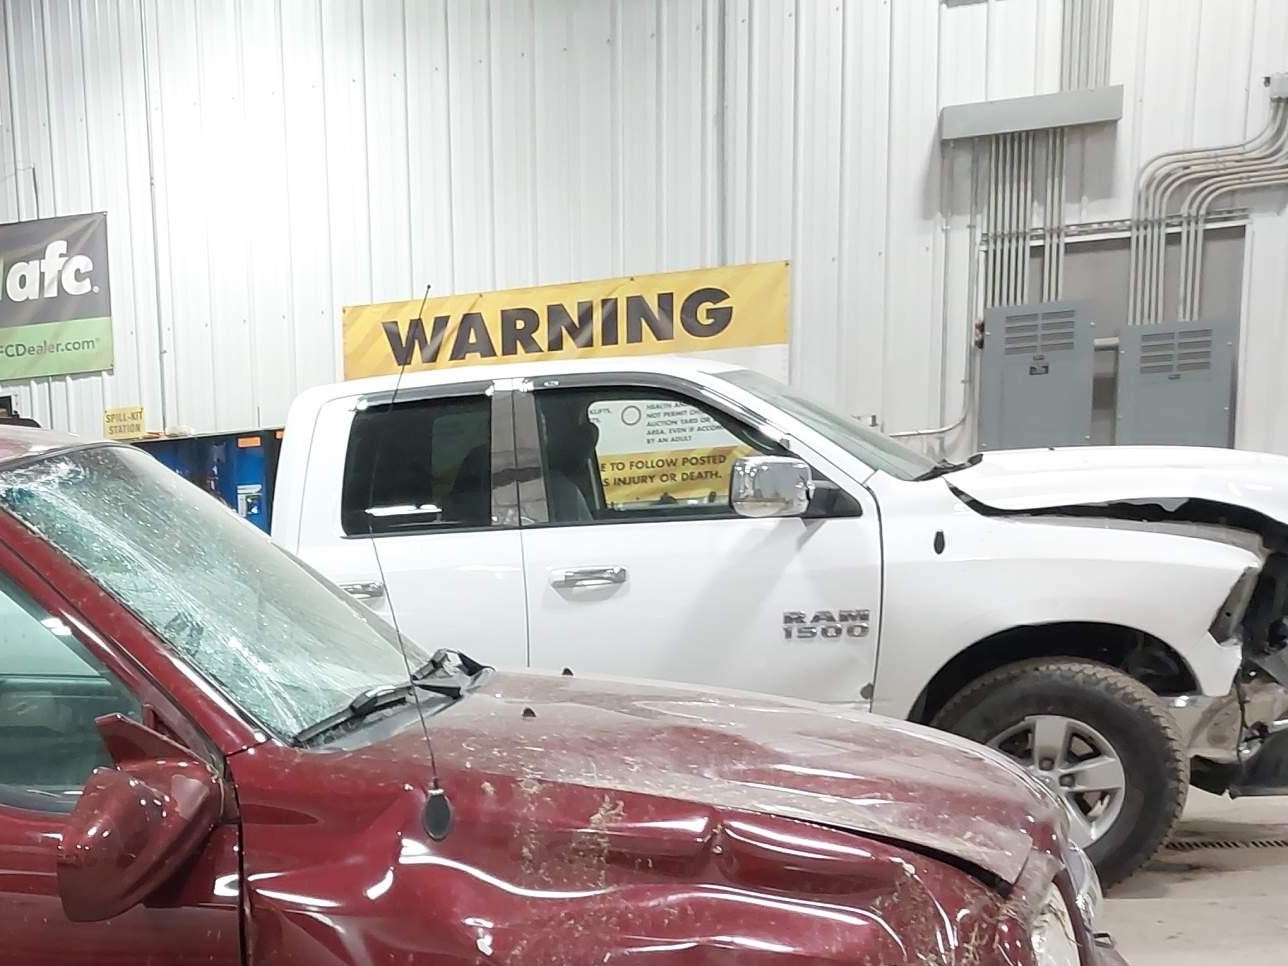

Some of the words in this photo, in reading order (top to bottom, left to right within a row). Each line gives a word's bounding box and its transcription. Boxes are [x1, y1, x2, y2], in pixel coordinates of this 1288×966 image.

[382, 287, 734, 367] WARNING
[109, 423, 141, 435] STATION
[610, 461, 626, 471] TO
[629, 458, 679, 471] FOLLOW
[681, 454, 727, 467] POSTED
[613, 474, 656, 486] INJURY
[659, 473, 677, 483] OR
[681, 470, 723, 482] DEATH.
[783, 609, 870, 624] RAM
[783, 623, 870, 639] 1500
